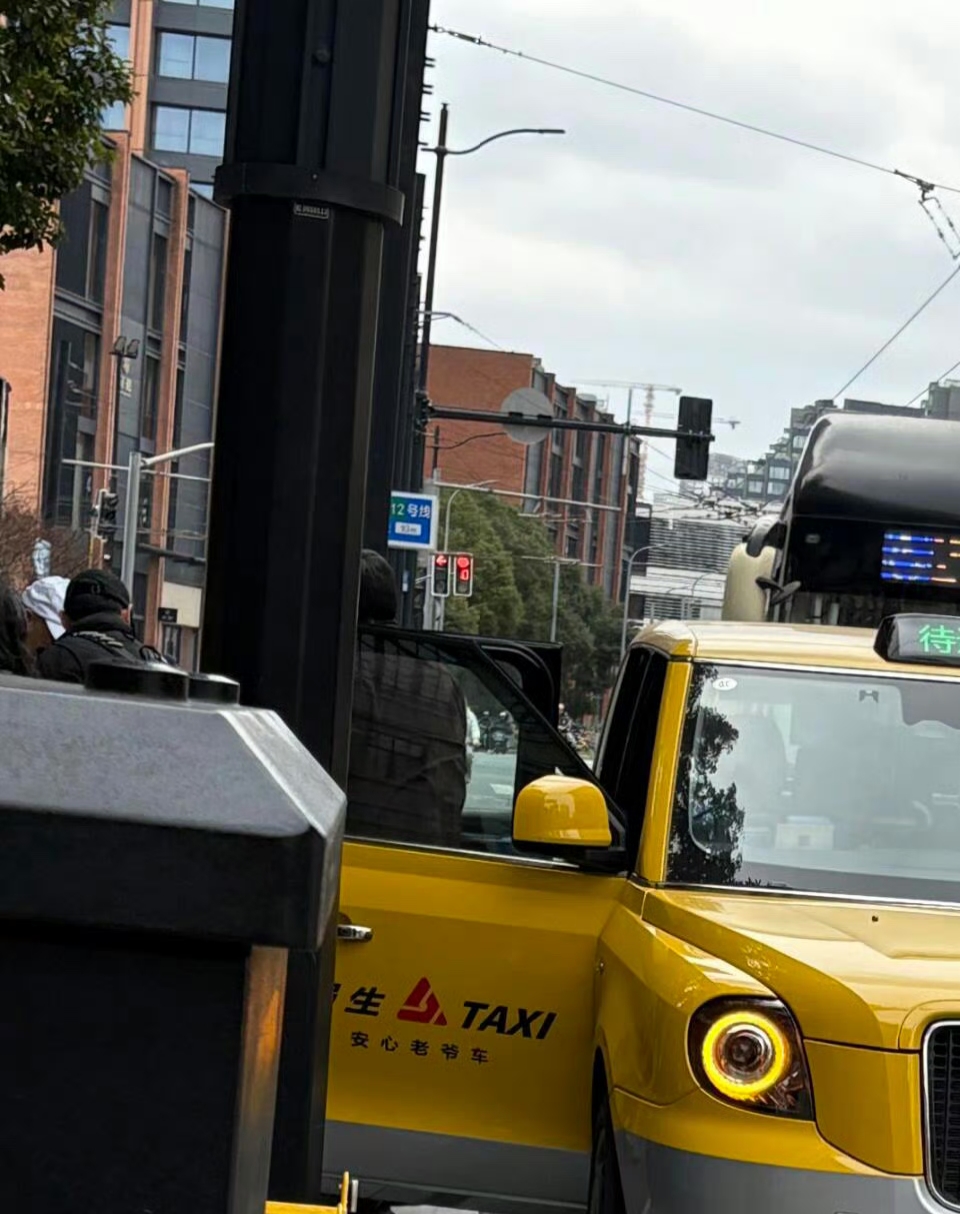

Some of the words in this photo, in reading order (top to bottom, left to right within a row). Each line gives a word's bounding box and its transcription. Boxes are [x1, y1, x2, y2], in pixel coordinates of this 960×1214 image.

[331, 983, 386, 1017] 生
[461, 1001, 557, 1040] TAXI
[351, 1031, 489, 1065] 安心老爷车
